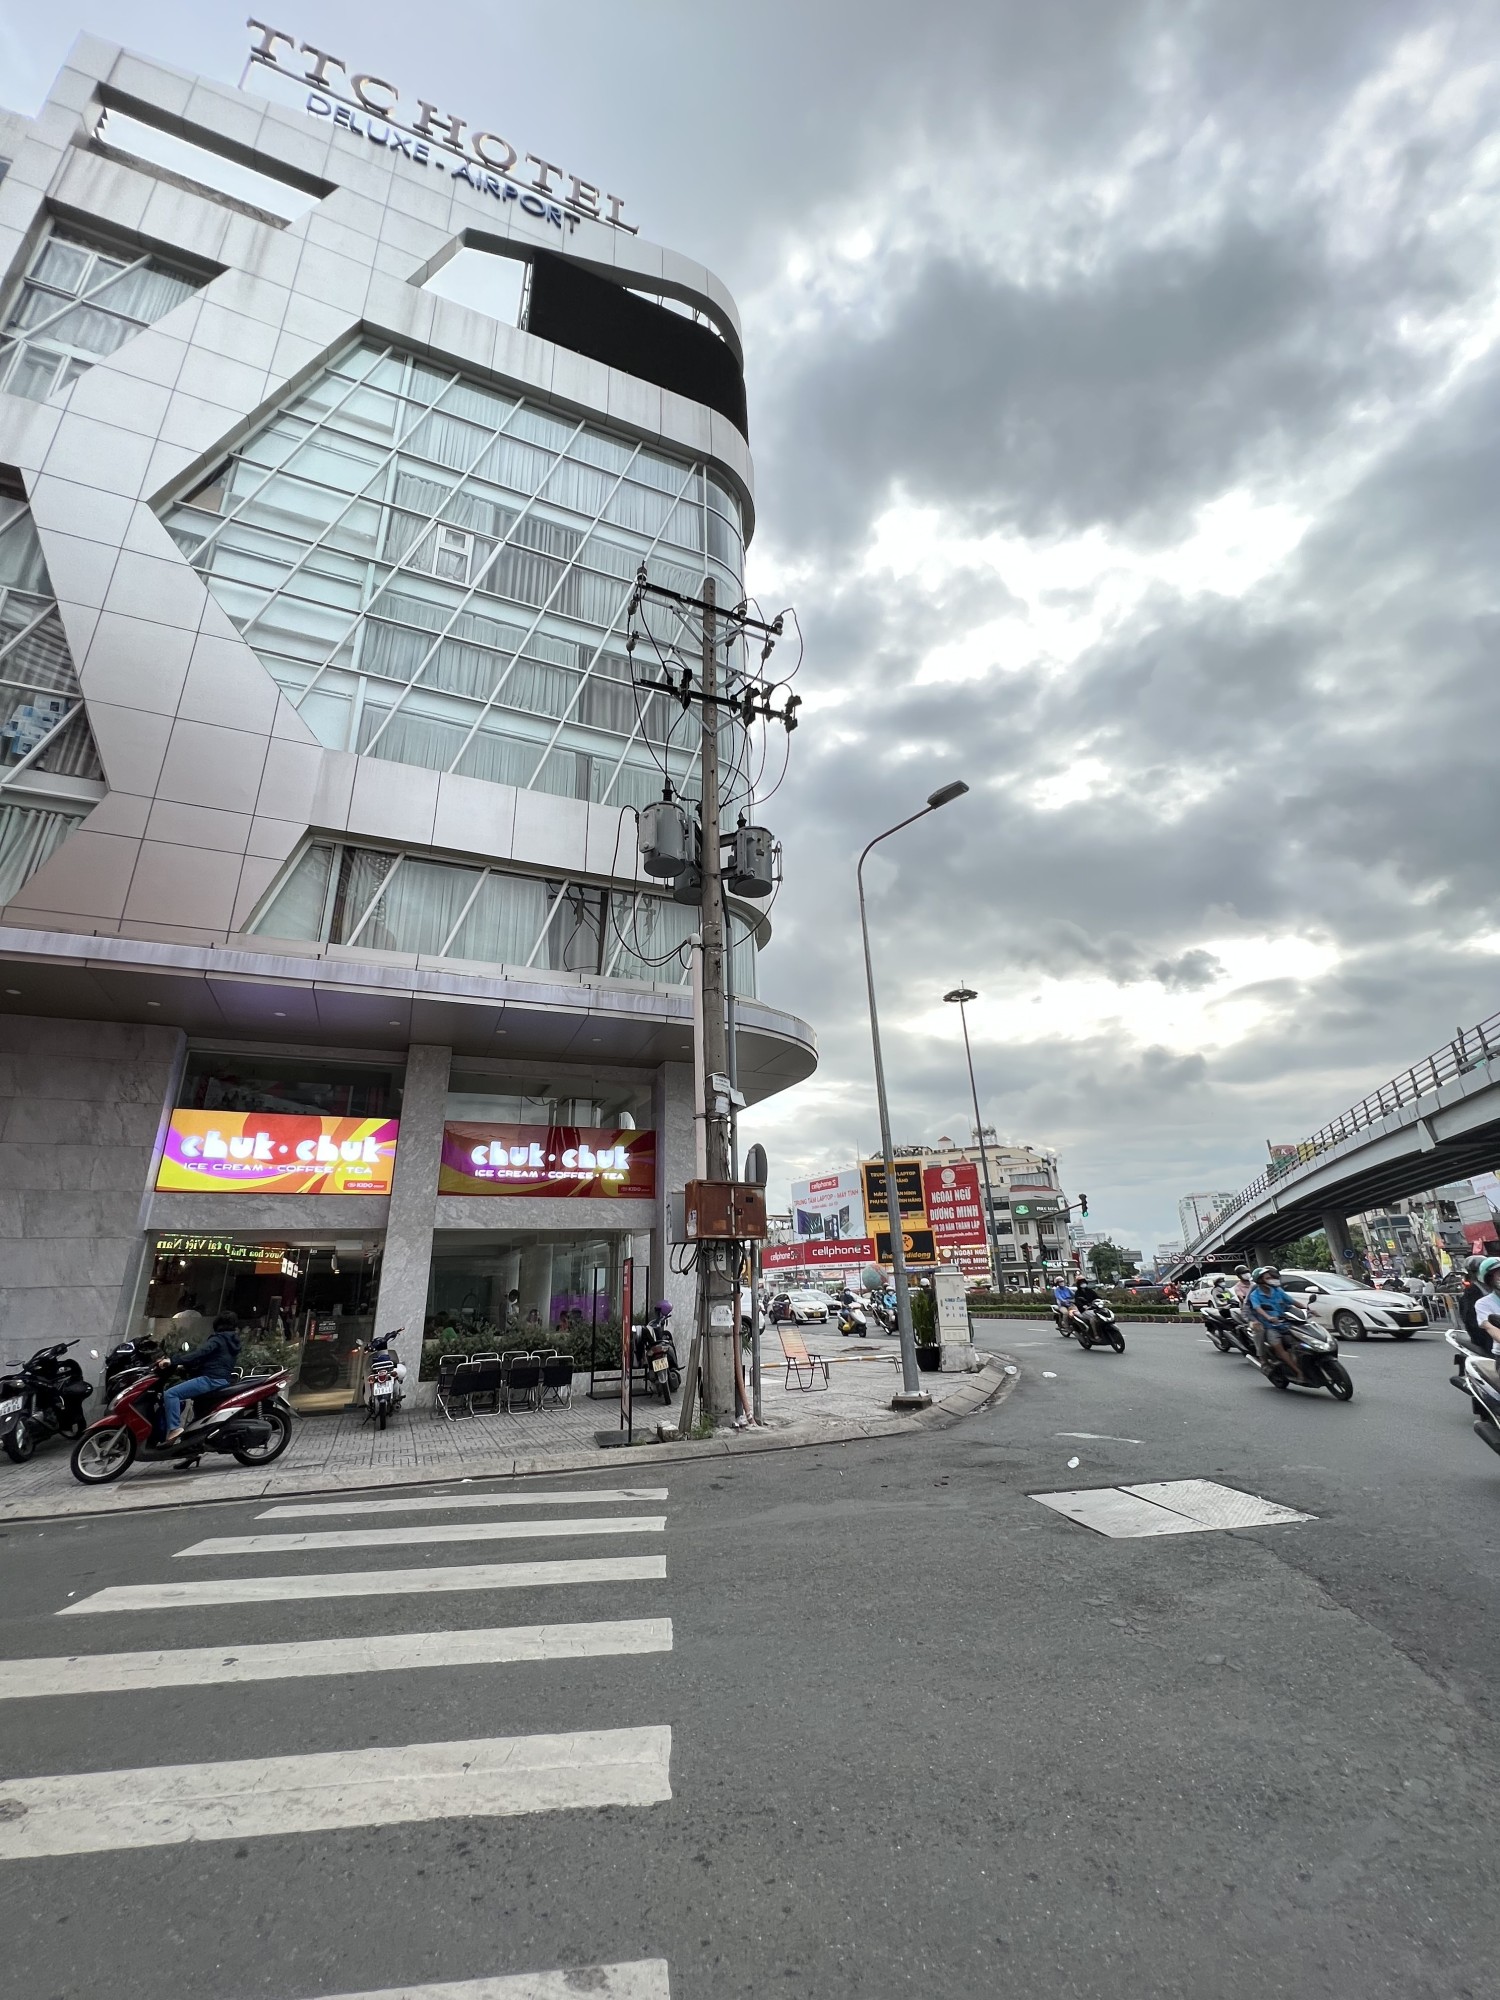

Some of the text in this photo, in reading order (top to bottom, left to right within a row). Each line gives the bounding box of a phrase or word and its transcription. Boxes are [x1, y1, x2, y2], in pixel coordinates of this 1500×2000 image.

[246, 15, 640, 236] TTC HOTEL
[306, 91, 432, 166] DELUXE
[451, 160, 581, 235] AIRPORT
[181, 1131, 382, 1163] chuk chuk
[471, 1141, 630, 1170] chuk chuk
[183, 1162, 373, 1174] ICE CREAM COFFEE TEA
[474, 1169, 625, 1180] ICE CREAM COFFEE TEA
[931, 1190, 953, 1204] NGOẠI
[954, 1186, 971, 1201] NGỮ
[930, 1204, 979, 1221] DƯƠNG MINH
